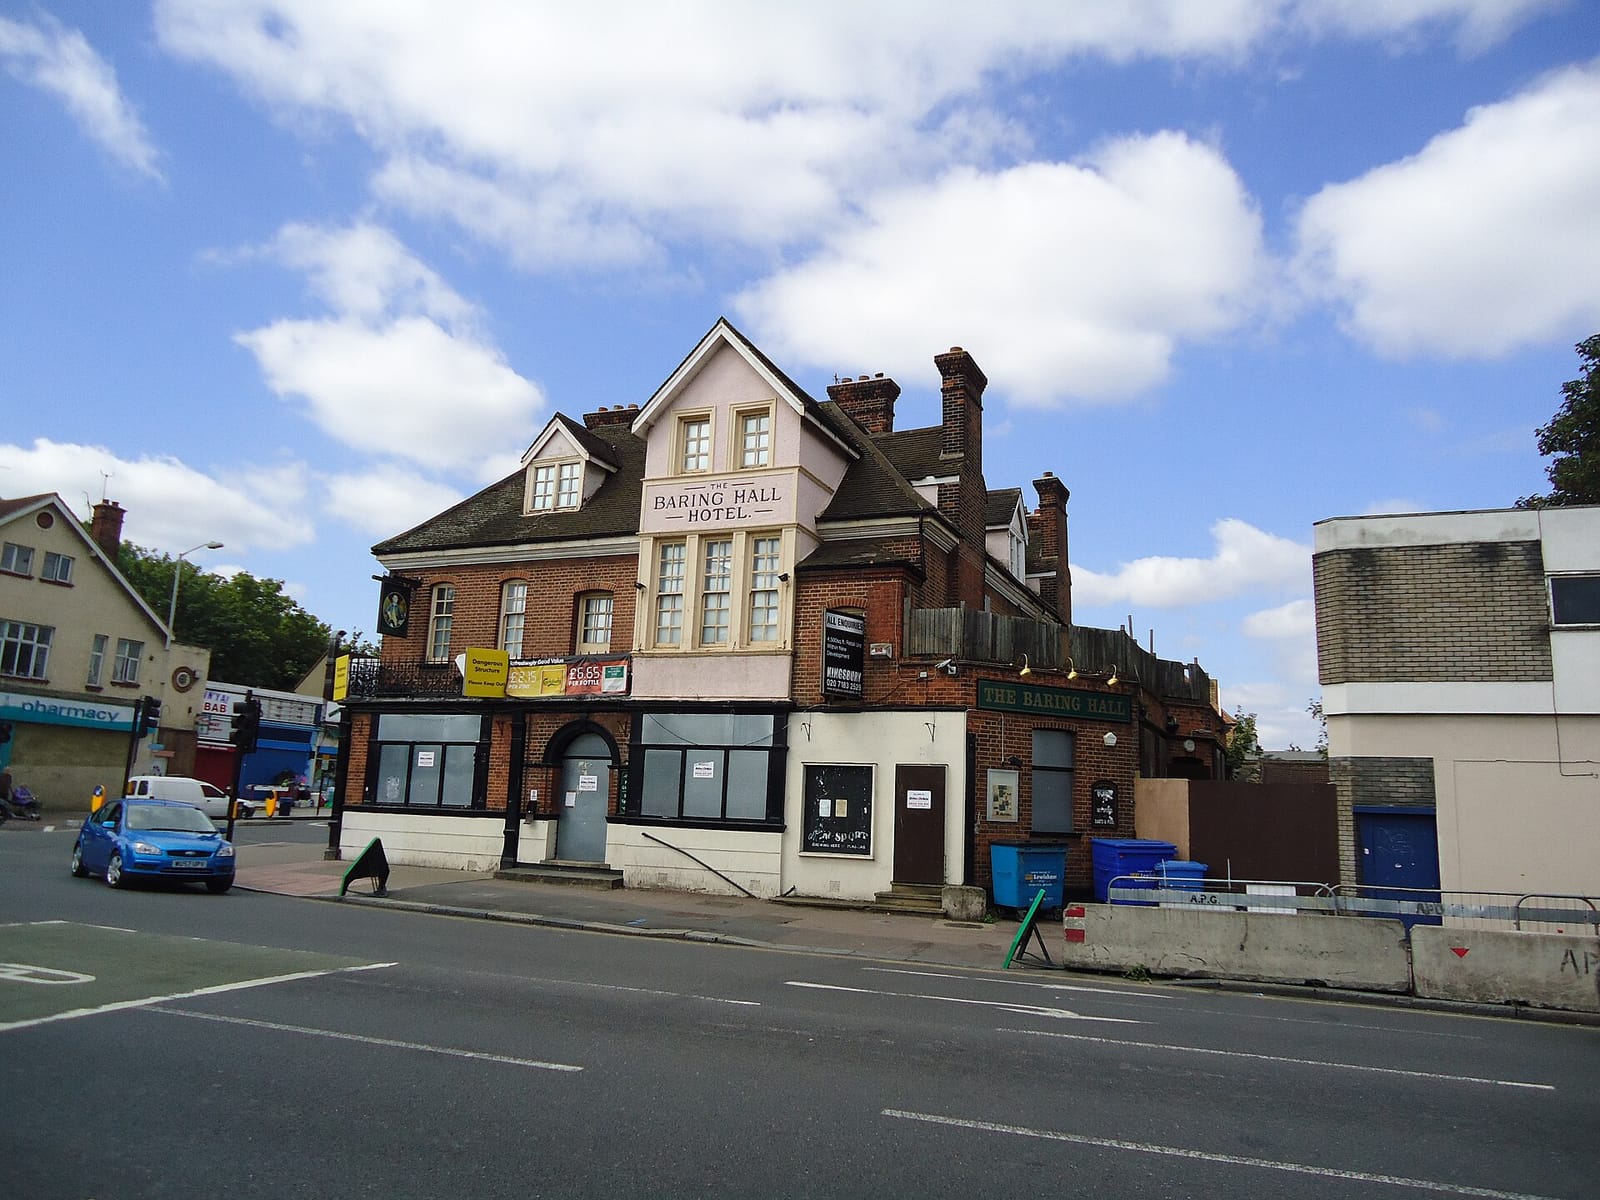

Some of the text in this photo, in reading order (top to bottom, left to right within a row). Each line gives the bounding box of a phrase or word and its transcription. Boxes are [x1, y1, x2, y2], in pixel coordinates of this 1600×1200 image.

[710, 482, 728, 490] THE
[654, 487, 782, 510] BARING HALL
[472, 658, 503, 667] Dangerous
[475, 666, 500, 674] Structure
[826, 666, 862, 682] KINGSBURY
[826, 679, 837, 687] 020
[983, 687, 1126, 716] THE BARING HALL
[21, 700, 120, 722] pharmacy
